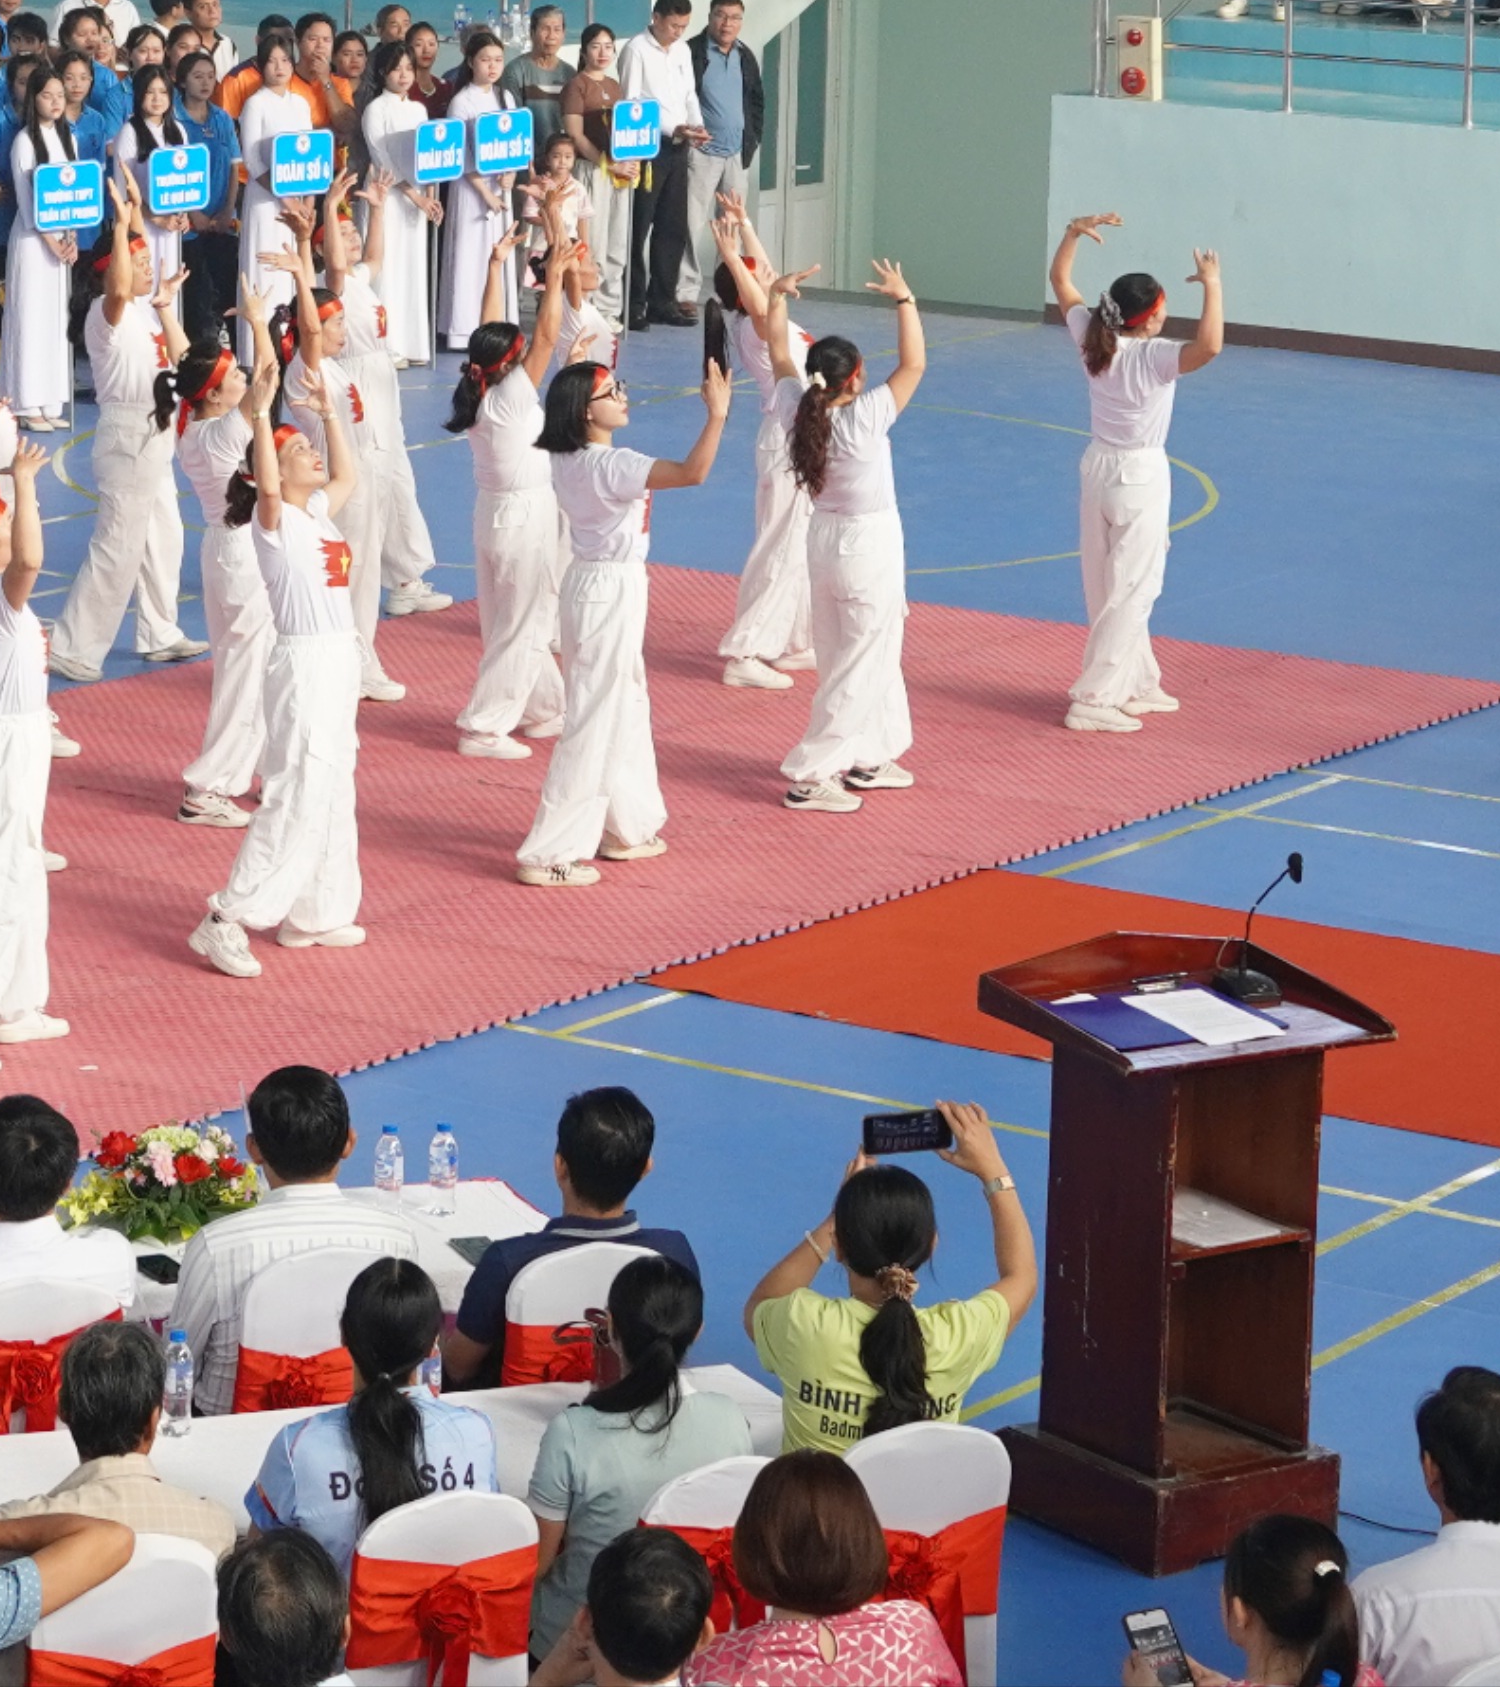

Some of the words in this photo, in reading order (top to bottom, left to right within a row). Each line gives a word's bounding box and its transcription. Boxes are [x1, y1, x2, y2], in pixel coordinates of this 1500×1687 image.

[480, 137, 508, 161] ĐOÀN
[509, 132, 523, 158] SỐ
[523, 137, 531, 156] 2
[638, 122, 652, 145] SỐ
[276, 159, 305, 183] ĐOÀN
[306, 153, 322, 181] SỐ
[442, 142, 456, 168] SỐ
[799, 1379, 861, 1416] BÌNH
[820, 1414, 863, 1440] Badm
[419, 1455, 457, 1493] Số
[463, 1461, 475, 1490] 4
